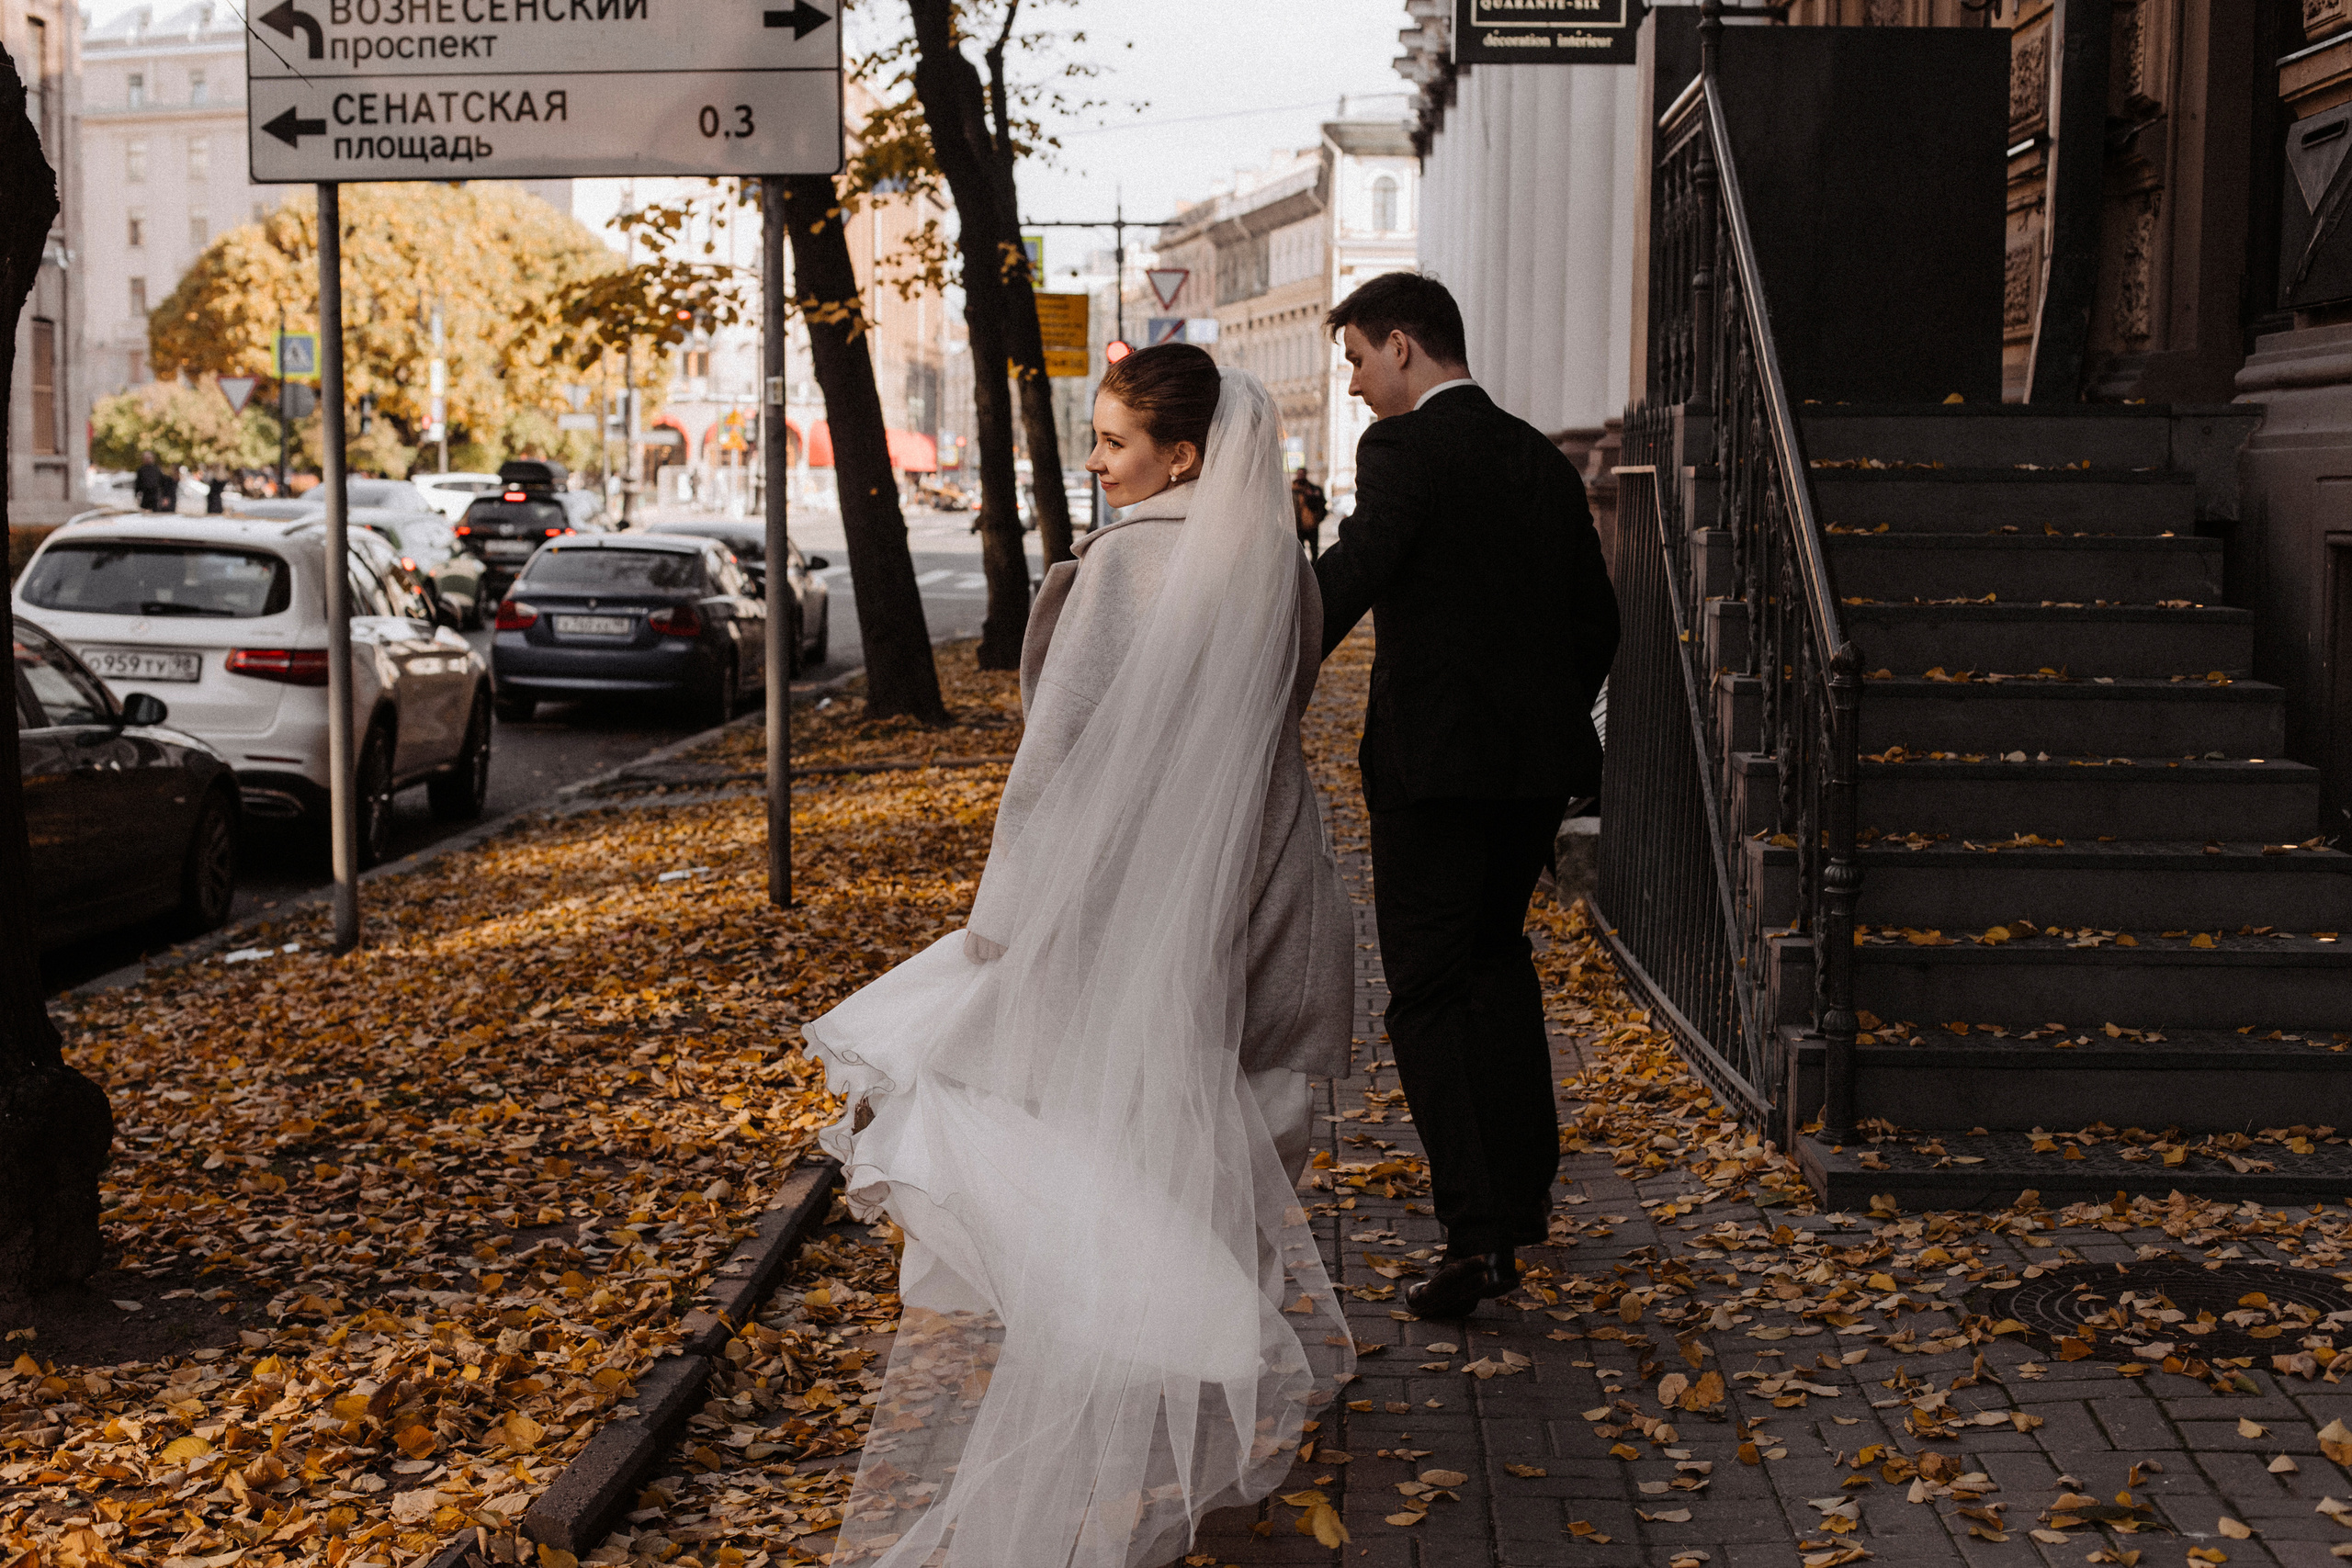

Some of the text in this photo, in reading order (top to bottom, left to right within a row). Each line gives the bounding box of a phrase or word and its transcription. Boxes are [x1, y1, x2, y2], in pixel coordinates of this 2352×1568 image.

[331, 35, 498, 68] проспект
[333, 90, 567, 125] СЕНАТСКАЯ
[334, 134, 493, 164] площадь
